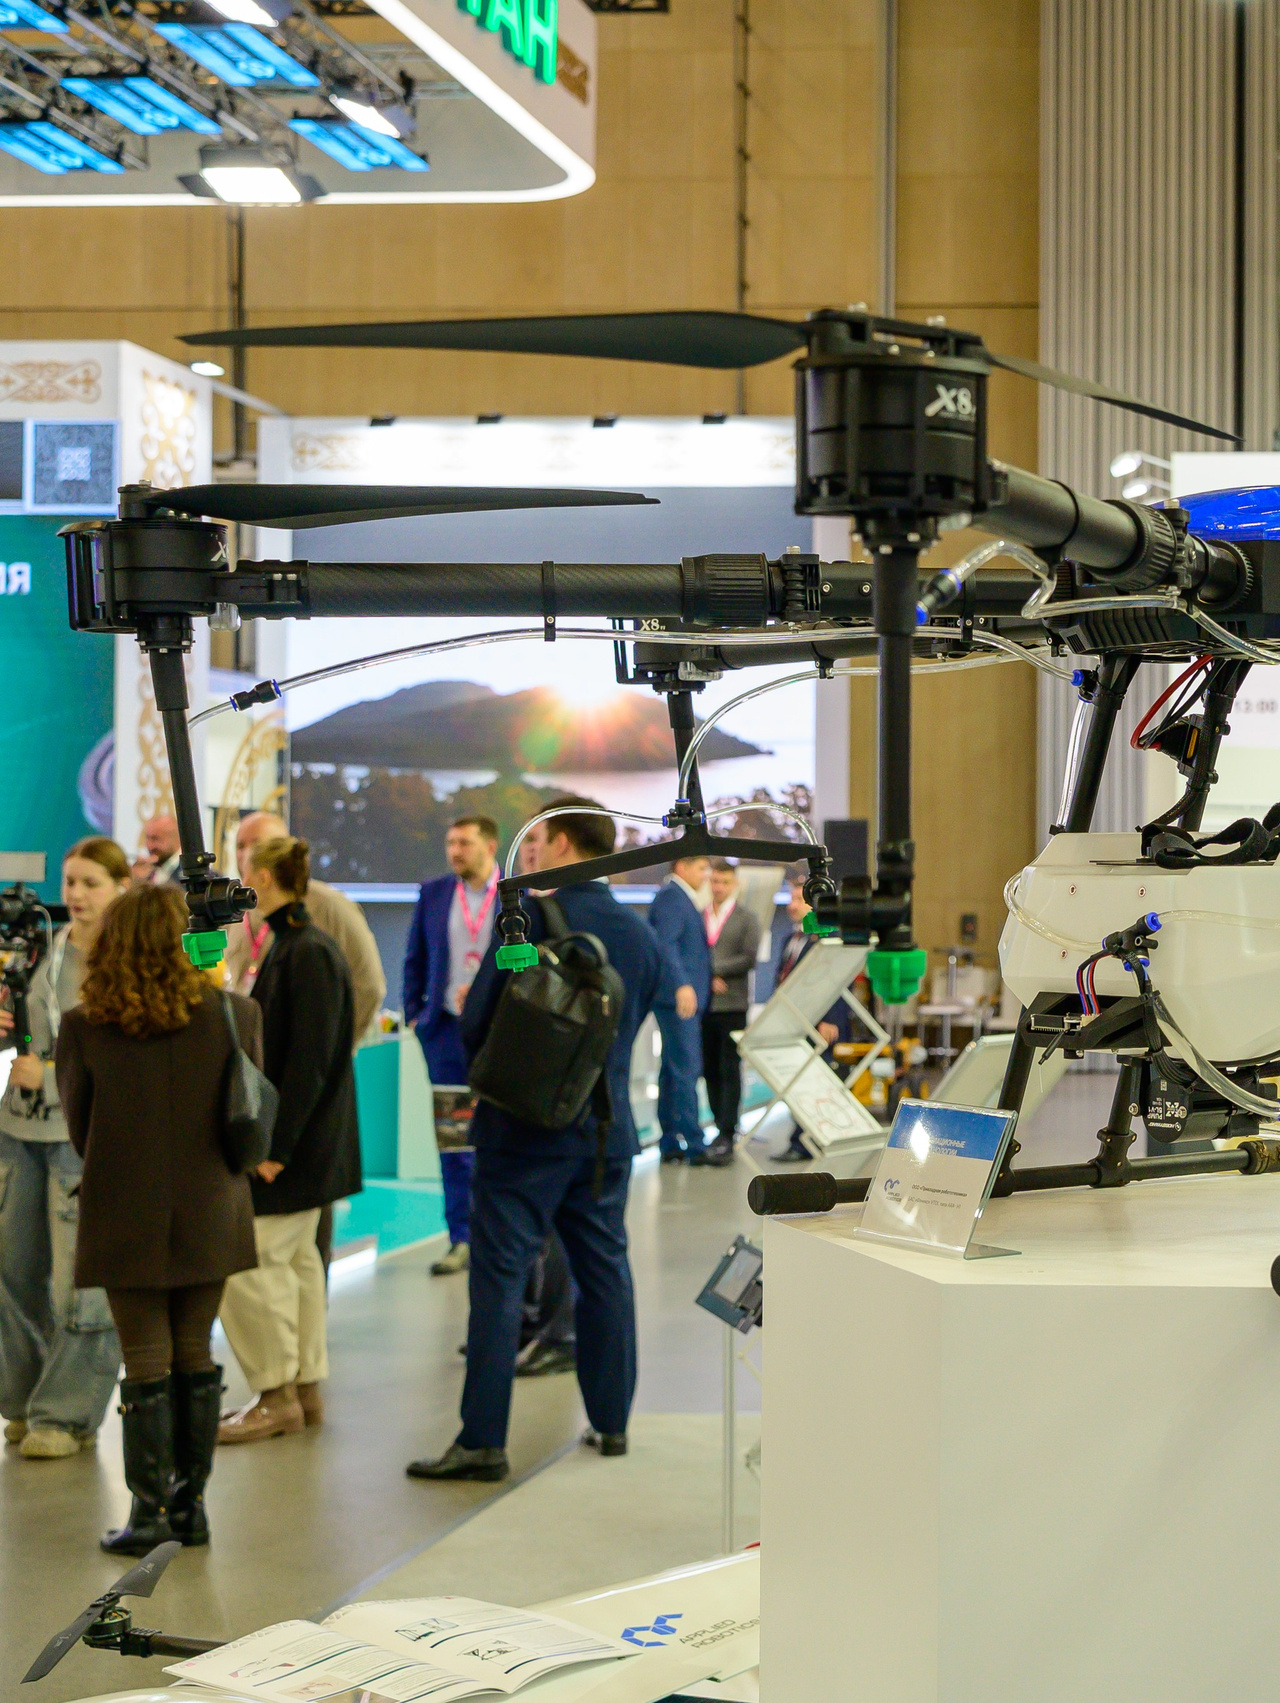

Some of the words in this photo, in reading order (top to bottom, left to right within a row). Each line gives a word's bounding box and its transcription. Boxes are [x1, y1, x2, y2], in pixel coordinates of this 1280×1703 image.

[925, 384, 972, 417] X8
[641, 618, 660, 631] X8
[679, 1619, 736, 1644] APPLIED
[691, 1618, 760, 1649] ROBOTICS
